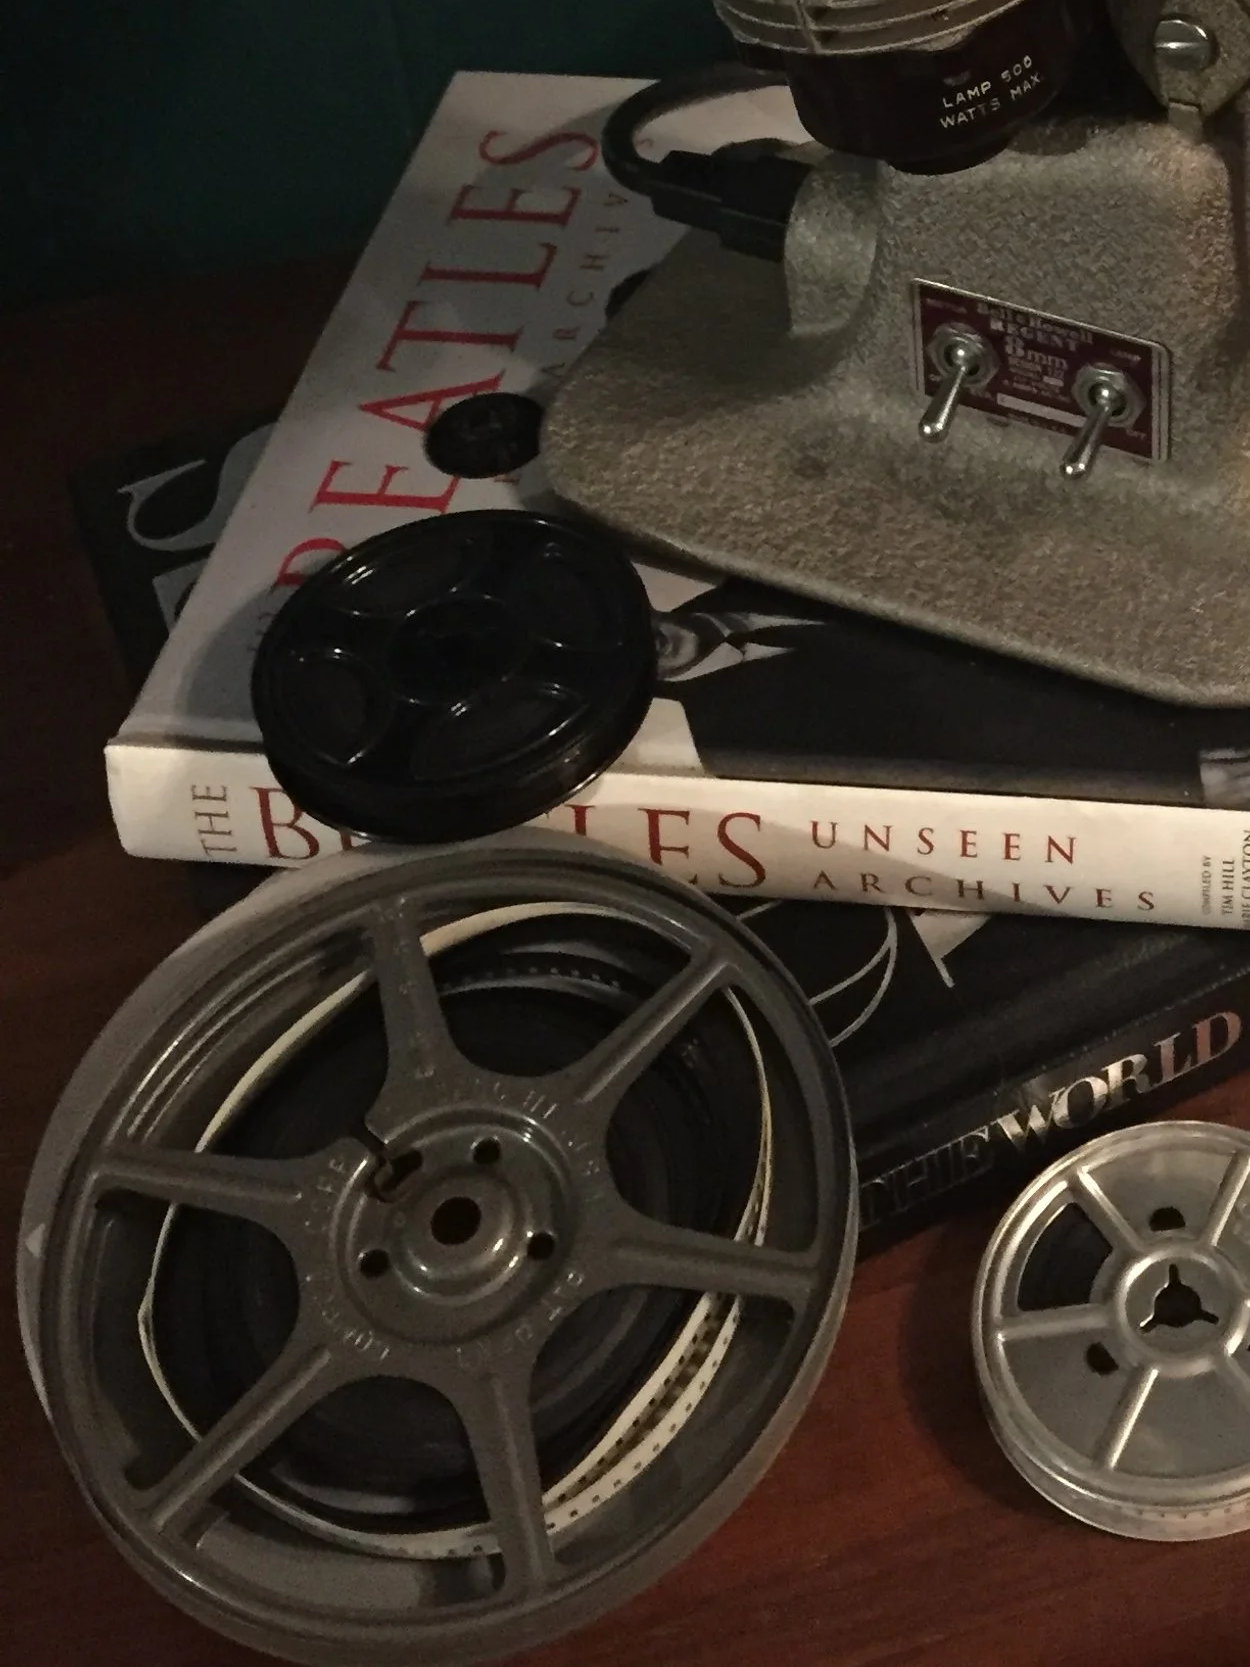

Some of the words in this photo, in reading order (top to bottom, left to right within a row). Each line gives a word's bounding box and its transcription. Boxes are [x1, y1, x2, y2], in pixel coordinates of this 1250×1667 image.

[939, 97, 1001, 129] WATTS
[1009, 71, 1042, 102] MAX
[941, 80, 993, 109] LAMP
[1000, 54, 1033, 84] 500
[191, 784, 237, 857] THE
[810, 820, 1077, 865] UNSEEN
[813, 870, 1156, 912] ARCHIVES
[1222, 859, 1235, 891] HILL
[1221, 895, 1234, 915] TIM
[997, 1010, 1244, 1154] WORLD
